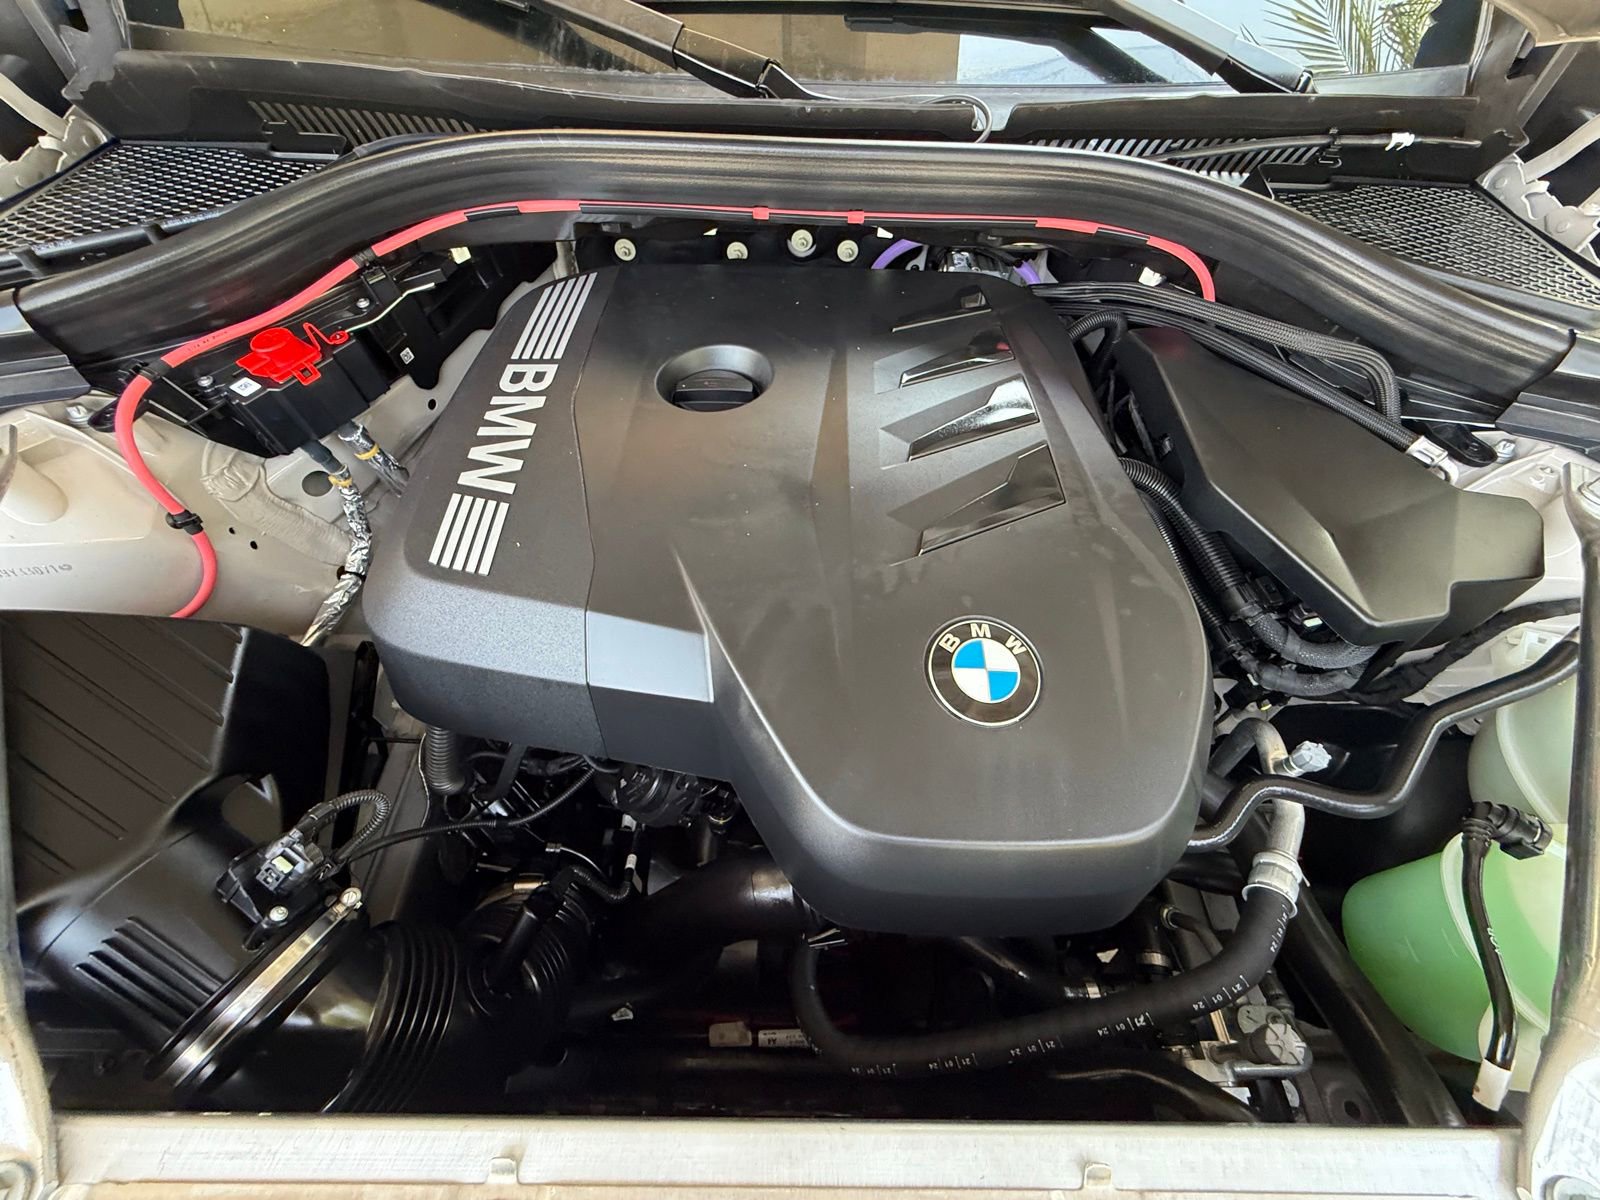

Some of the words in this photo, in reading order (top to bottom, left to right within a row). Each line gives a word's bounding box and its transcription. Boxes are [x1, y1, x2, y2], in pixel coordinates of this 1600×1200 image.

[457, 363, 559, 495] BMW
[938, 623, 1027, 655] BMW
[1232, 984, 1242, 993] 21
[1212, 994, 1222, 1003] 01
[1193, 1001, 1205, 1010] 24
